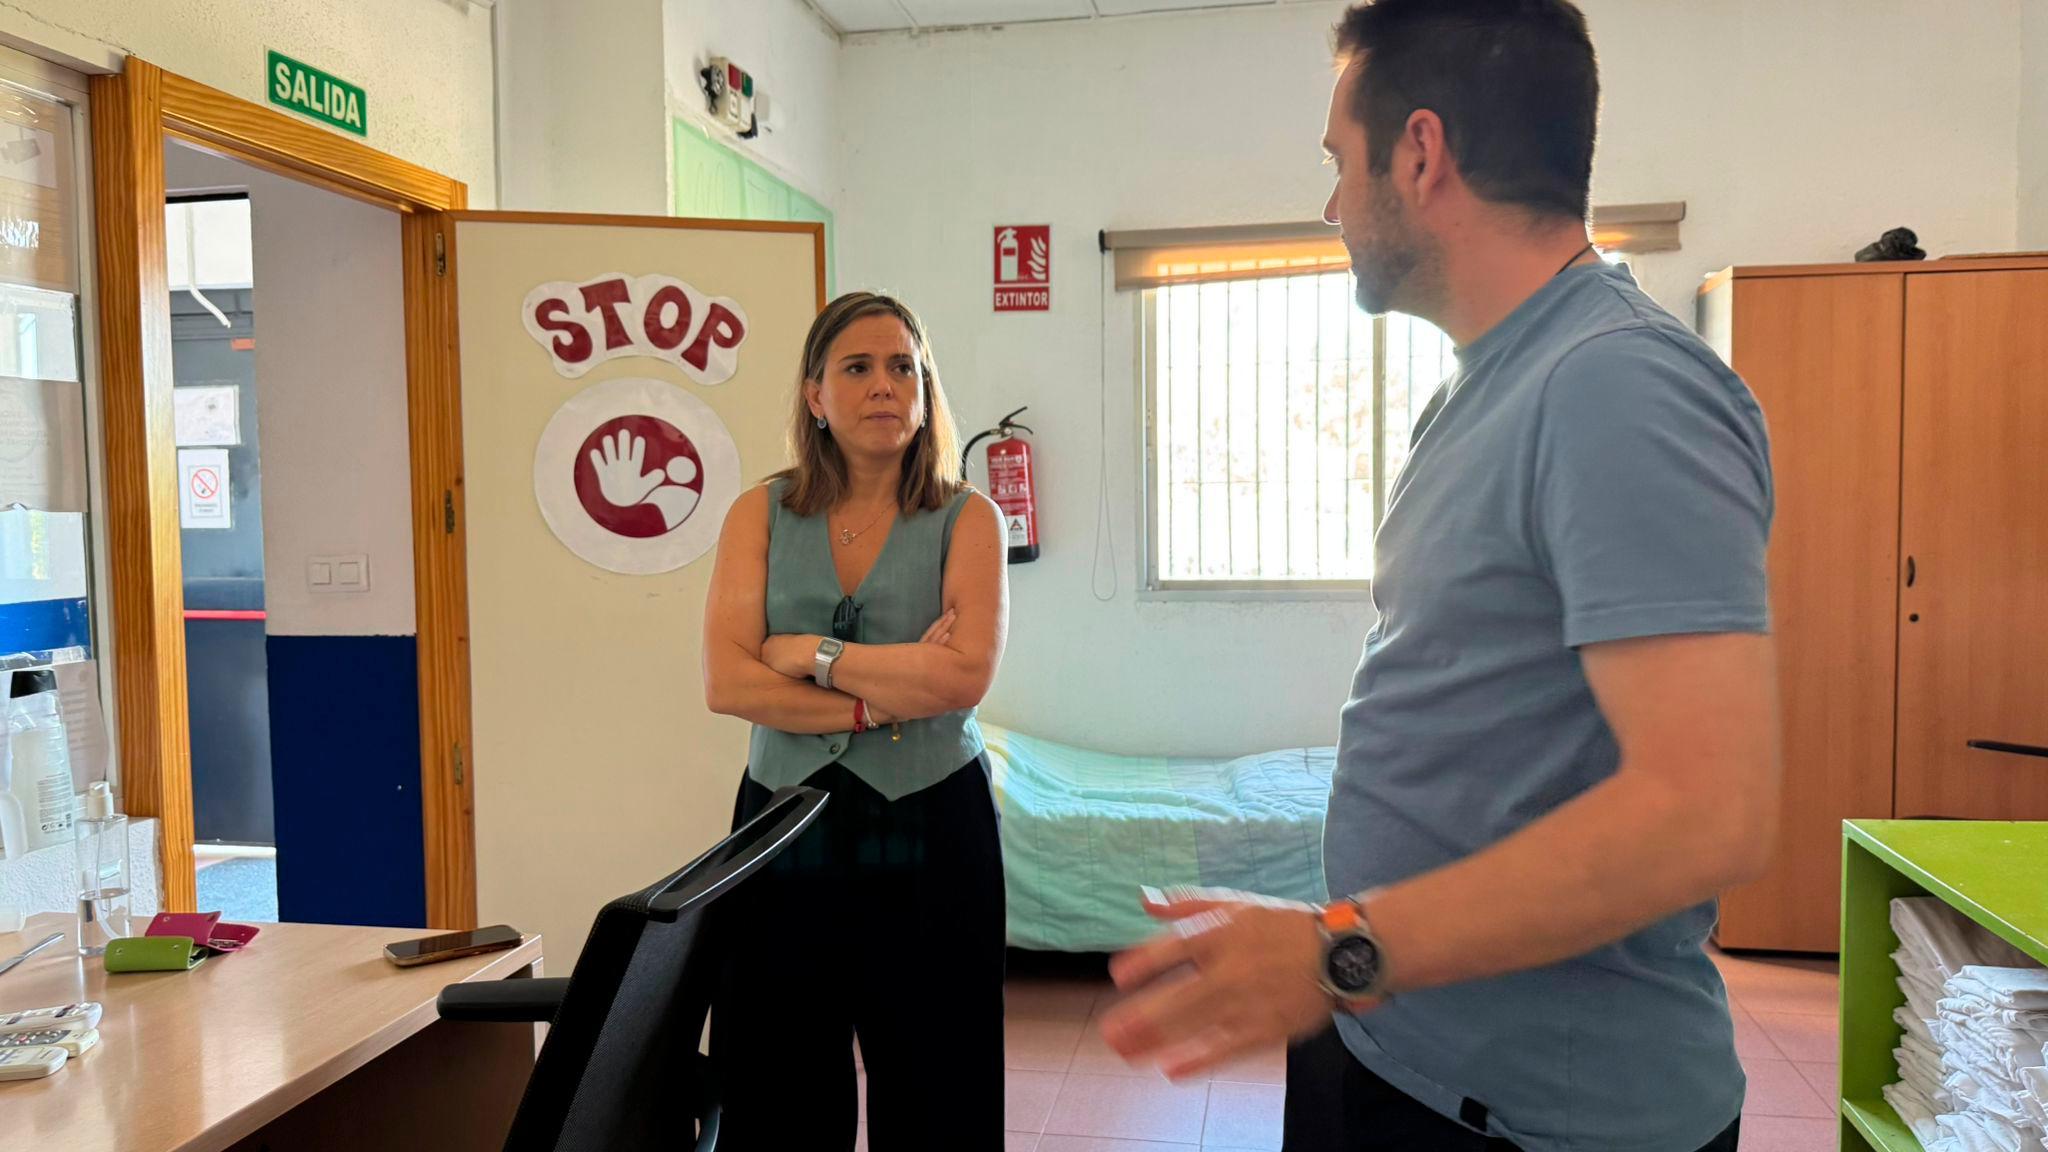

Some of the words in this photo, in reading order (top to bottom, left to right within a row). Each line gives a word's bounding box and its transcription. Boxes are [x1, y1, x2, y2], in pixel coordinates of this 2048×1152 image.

[275, 61, 361, 129] SALIDA
[535, 278, 745, 372] STOP
[995, 292, 1048, 306] EXTINTOR
